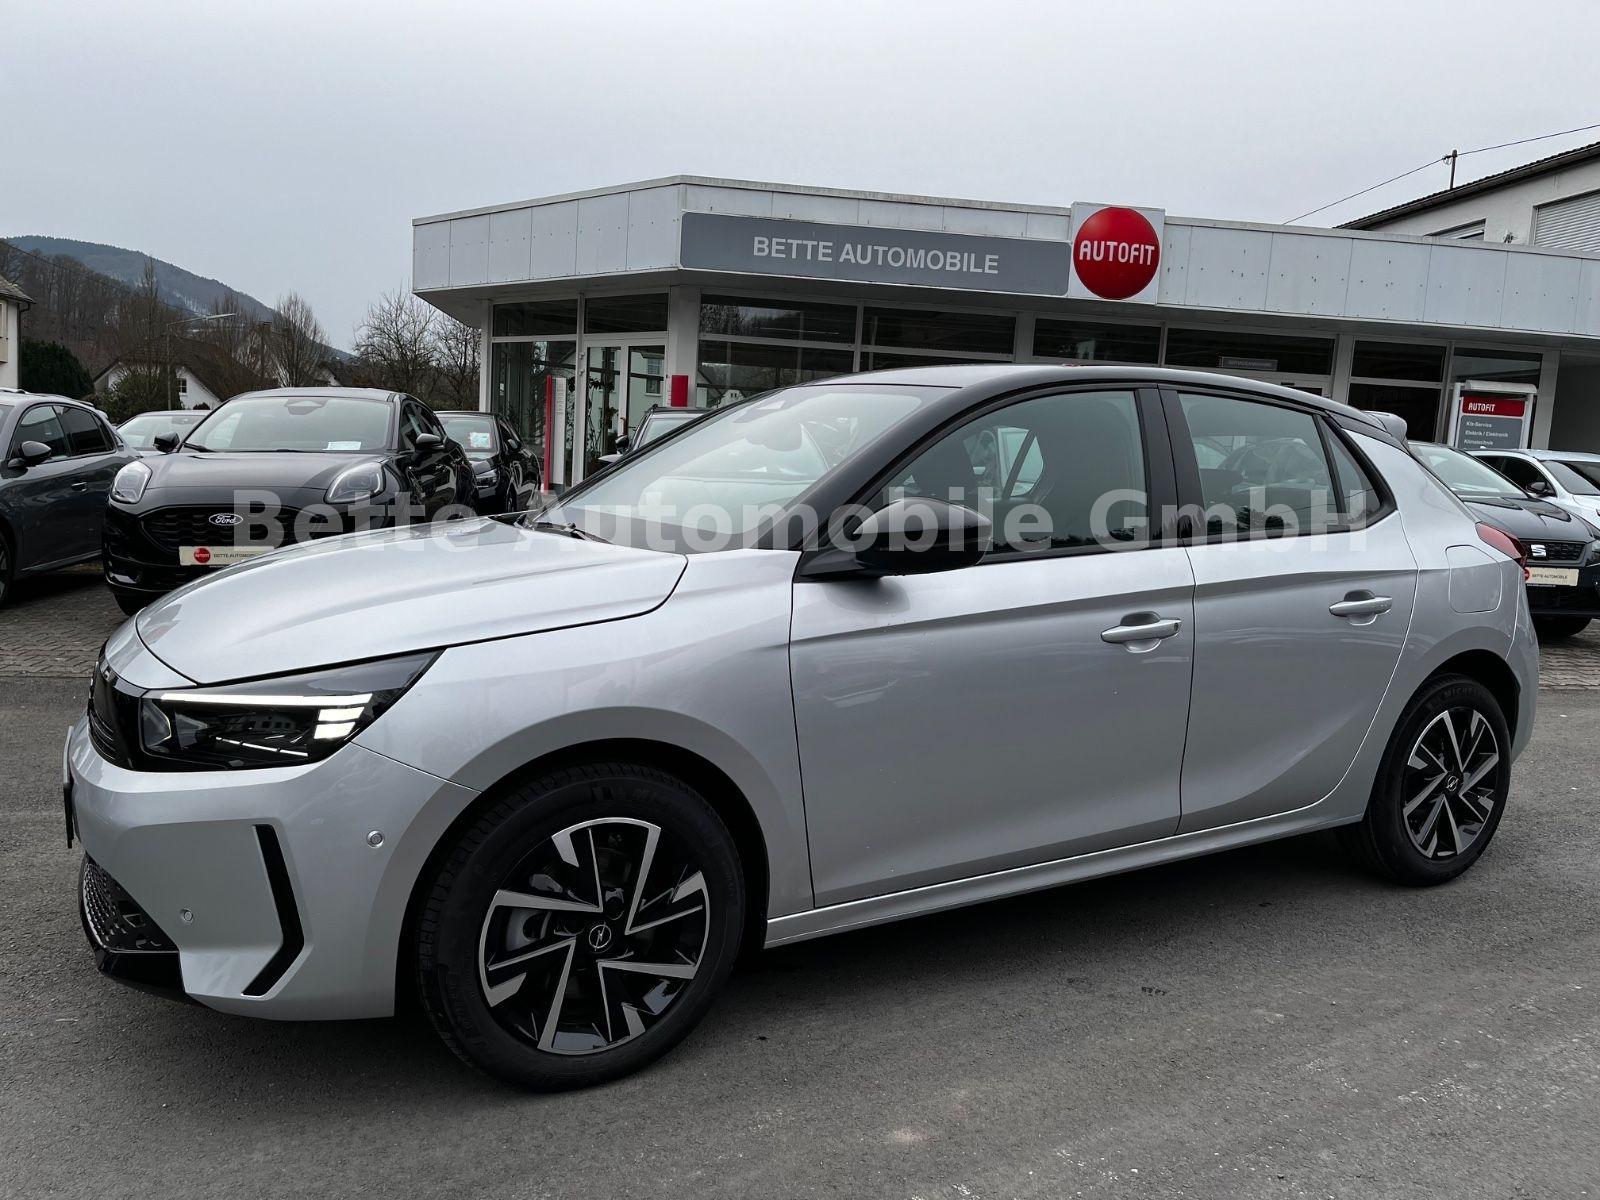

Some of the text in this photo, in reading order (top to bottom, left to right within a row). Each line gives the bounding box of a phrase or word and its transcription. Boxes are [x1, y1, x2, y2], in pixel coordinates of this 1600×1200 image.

[753, 236, 999, 274] BETTE AUTOMOBILE
[1079, 240, 1155, 266] AUTOFIT
[1468, 402, 1496, 412] AUTOFIT
[215, 515, 237, 524] Ford
